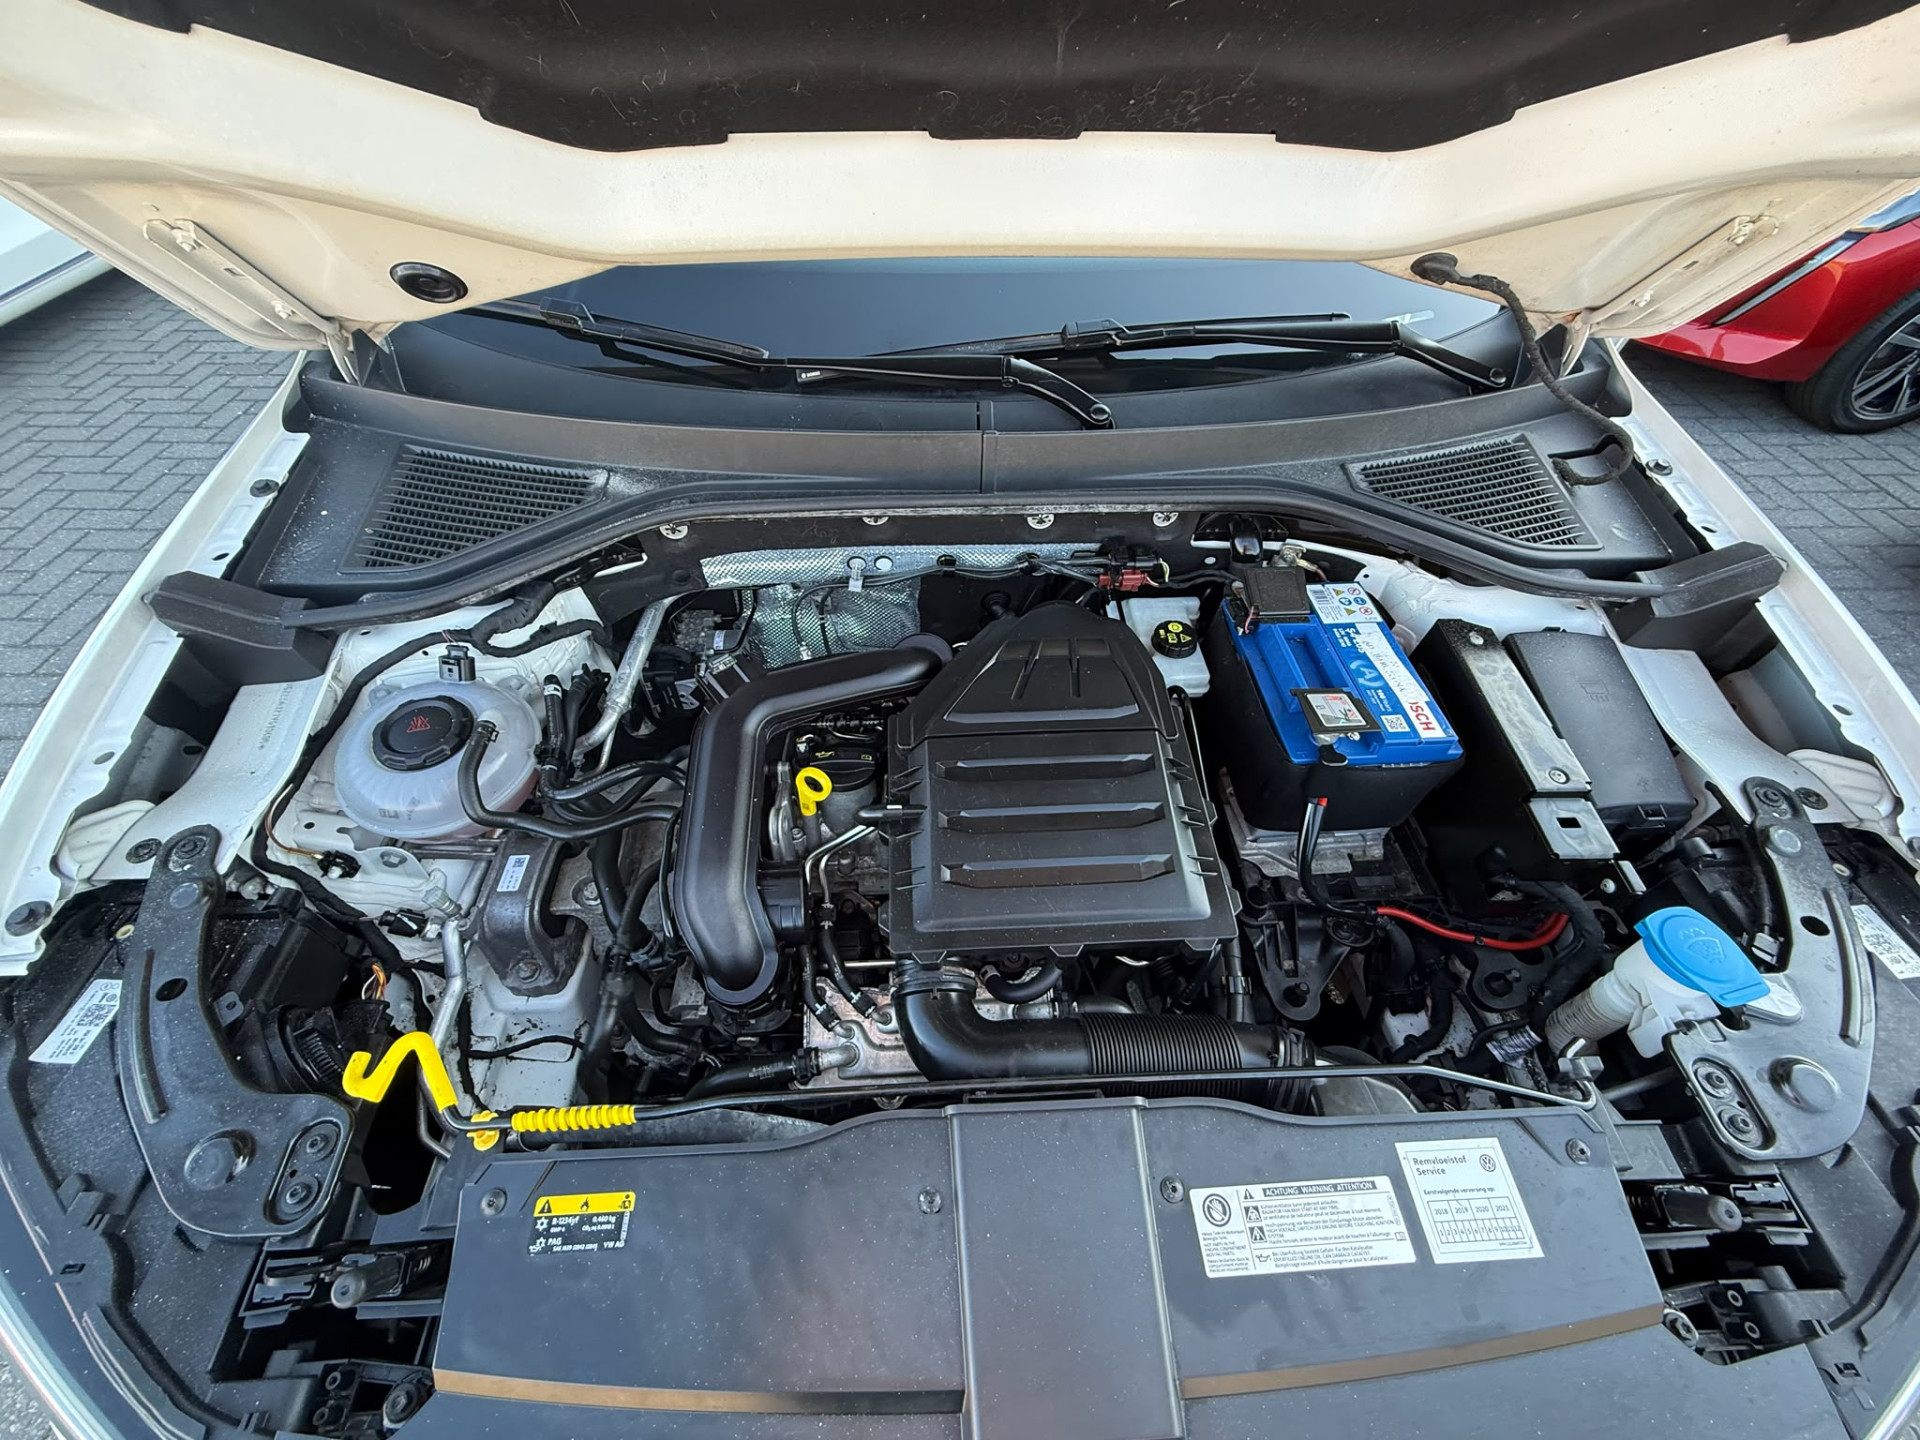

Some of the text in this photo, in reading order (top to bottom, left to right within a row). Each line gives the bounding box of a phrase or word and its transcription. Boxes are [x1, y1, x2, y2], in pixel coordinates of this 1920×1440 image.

[1409, 701, 1436, 731] SCH
[1412, 1155, 1467, 1166] Remvloeistof
[1416, 1166, 1446, 1176] Service
[1265, 1181, 1372, 1196] ACHTUNG WARNING ATTENTION
[1433, 1204, 1509, 1215] 2018 2019 2020 2021
[551, 1215, 579, 1226] R-1234yf
[547, 1236, 562, 1245] PAG
[602, 1240, 614, 1248] VW
